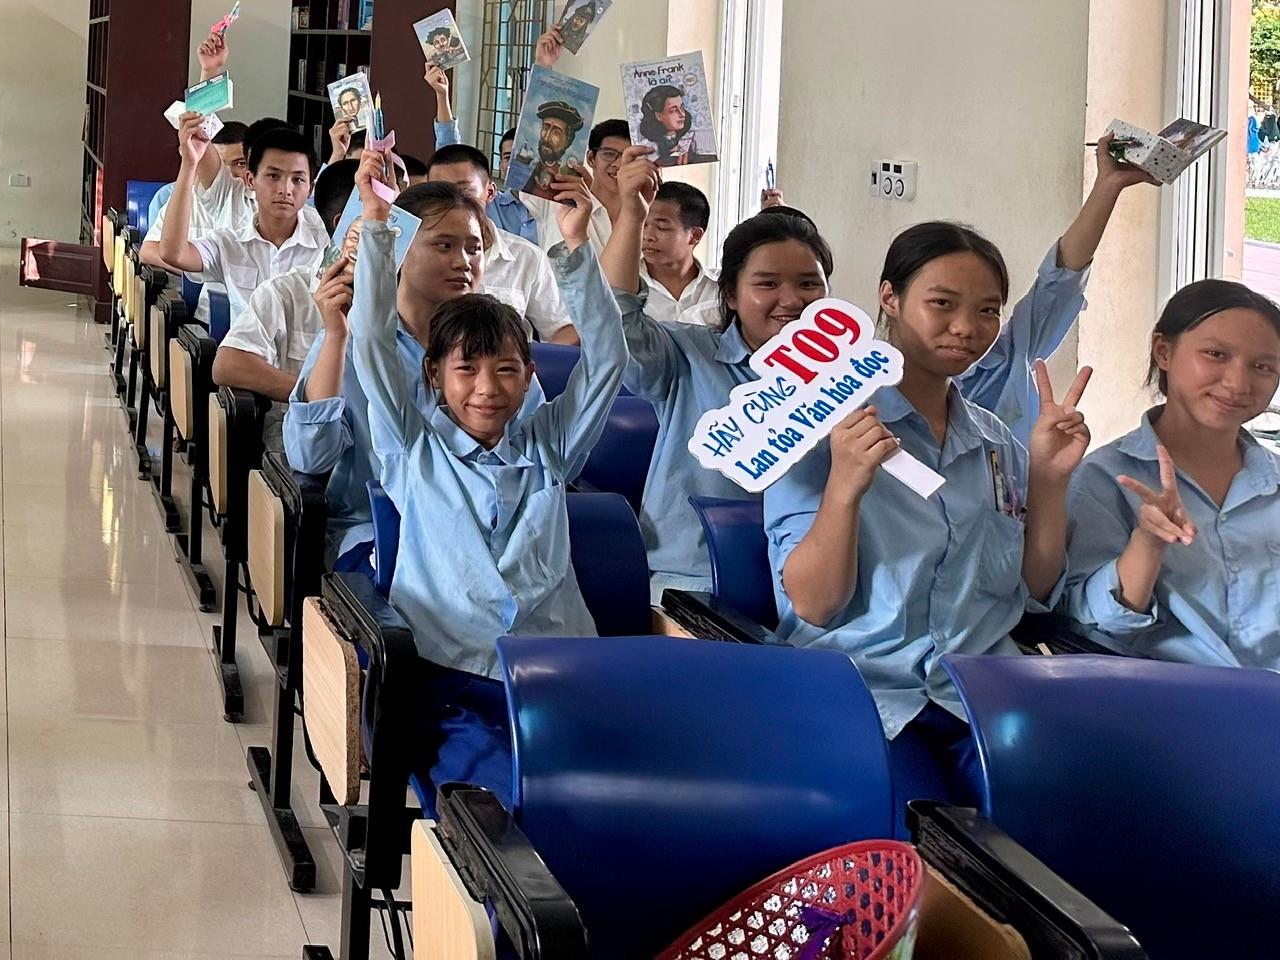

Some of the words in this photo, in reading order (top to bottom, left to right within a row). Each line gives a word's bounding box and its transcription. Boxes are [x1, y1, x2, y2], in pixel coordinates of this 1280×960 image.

[634, 68, 656, 78] Anne
[658, 62, 684, 75] Frank
[648, 77, 657, 86] là
[735, 444, 779, 481] Lan
[789, 396, 836, 430] Văn
[820, 378, 863, 404] hóa
[849, 349, 890, 379] đọc
